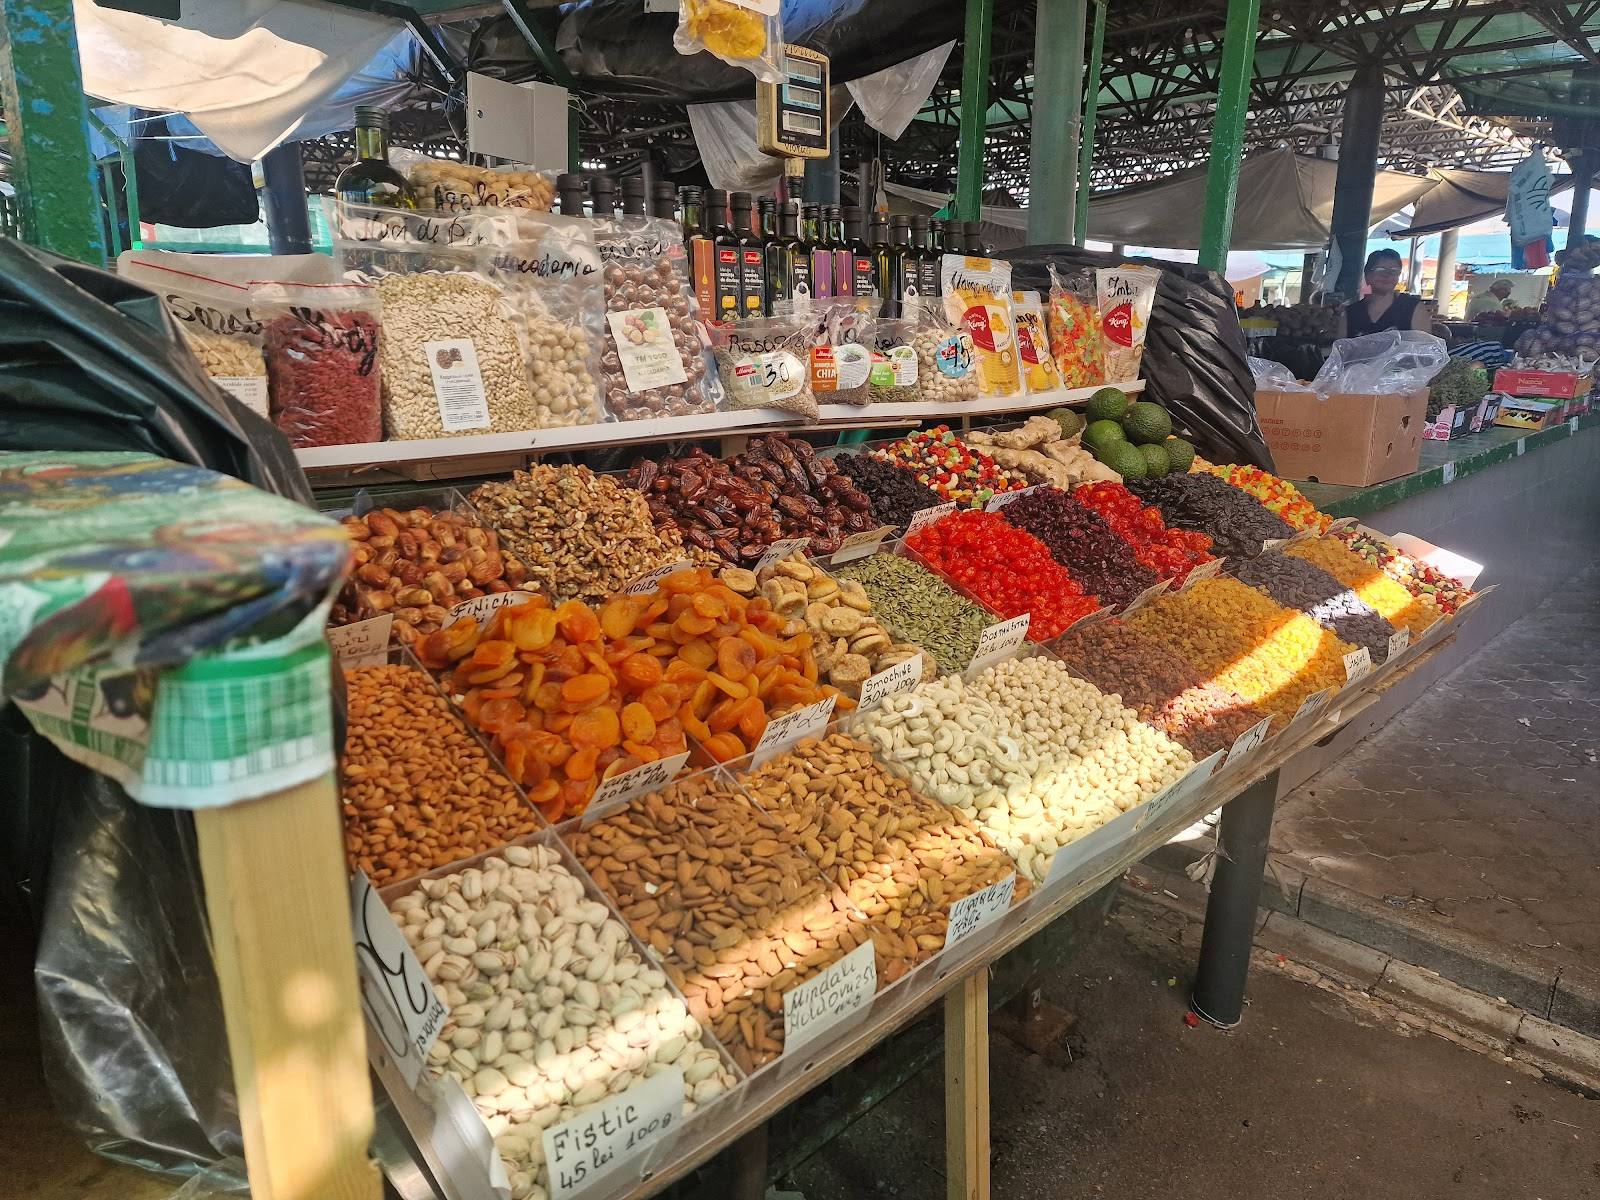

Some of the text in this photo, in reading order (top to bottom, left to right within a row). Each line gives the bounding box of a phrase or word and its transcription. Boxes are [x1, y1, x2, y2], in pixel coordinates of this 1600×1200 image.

[416, 217, 439, 243] de
[1109, 317, 1129, 329] King
[762, 362, 789, 388] 30
[816, 368, 837, 379] CHIA
[553, 1104, 638, 1163] Fistic
